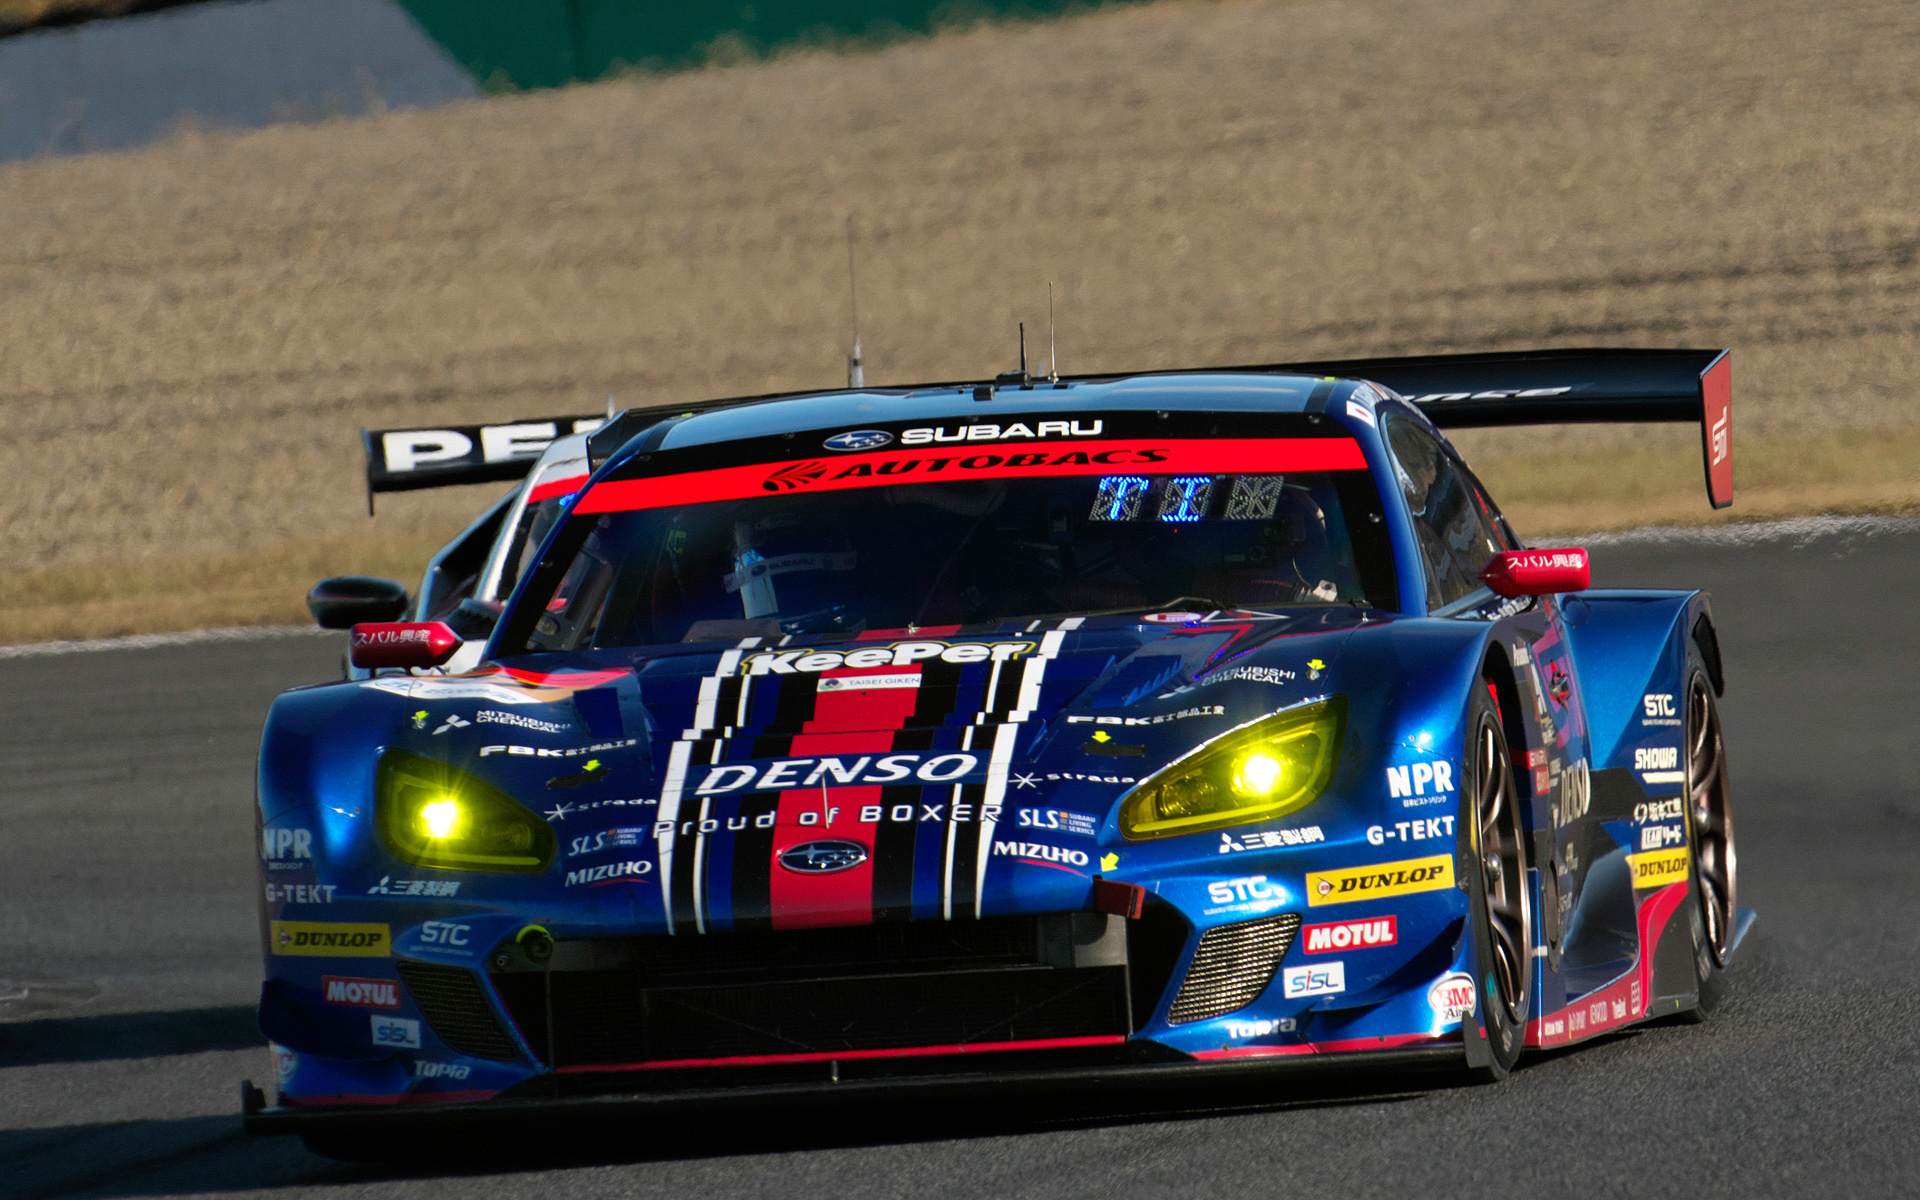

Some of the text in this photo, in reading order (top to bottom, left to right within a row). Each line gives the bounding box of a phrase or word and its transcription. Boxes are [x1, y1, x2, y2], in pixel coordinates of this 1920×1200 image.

[901, 420, 1103, 444] SUBARU
[383, 420, 605, 472] PE
[827, 448, 1170, 480] AUTOBACS
[1507, 553, 1583, 569] スバル興産
[354, 629, 431, 646] スバル興産
[746, 641, 1029, 675] KeePer
[849, 678, 882, 686] TAISEI
[1644, 694, 1676, 717] STC
[476, 715, 561, 734] CHEMICAL
[1067, 715, 1151, 725] FBK
[1634, 747, 1678, 770] SHOWA
[694, 753, 978, 795] DENSO
[1046, 772, 1136, 783] strada
[1387, 760, 1454, 798] NPR
[578, 798, 658, 811] strada
[652, 804, 1004, 838] Proud of BOXER
[1019, 808, 1059, 829] SLS
[1068, 813, 1096, 823] SUBARU
[1366, 815, 1455, 846] G-TEKT
[262, 828, 312, 860] NPR
[568, 831, 607, 857] SLS
[1241, 825, 1324, 850] 三菱製鋼
[993, 841, 1089, 866] MIZUHO
[564, 860, 653, 888] MIZUHO
[1338, 865, 1444, 893] DUNLOP
[1639, 857, 1687, 878] DUNLOP
[266, 884, 338, 904] G-TEKT
[1208, 876, 1272, 904] STC
[294, 931, 382, 948] DUNLOP
[420, 920, 472, 946] STC
[1307, 920, 1394, 951] MOTUL
[326, 980, 397, 1006] MOTUL
[1437, 986, 1473, 1007] BMC
